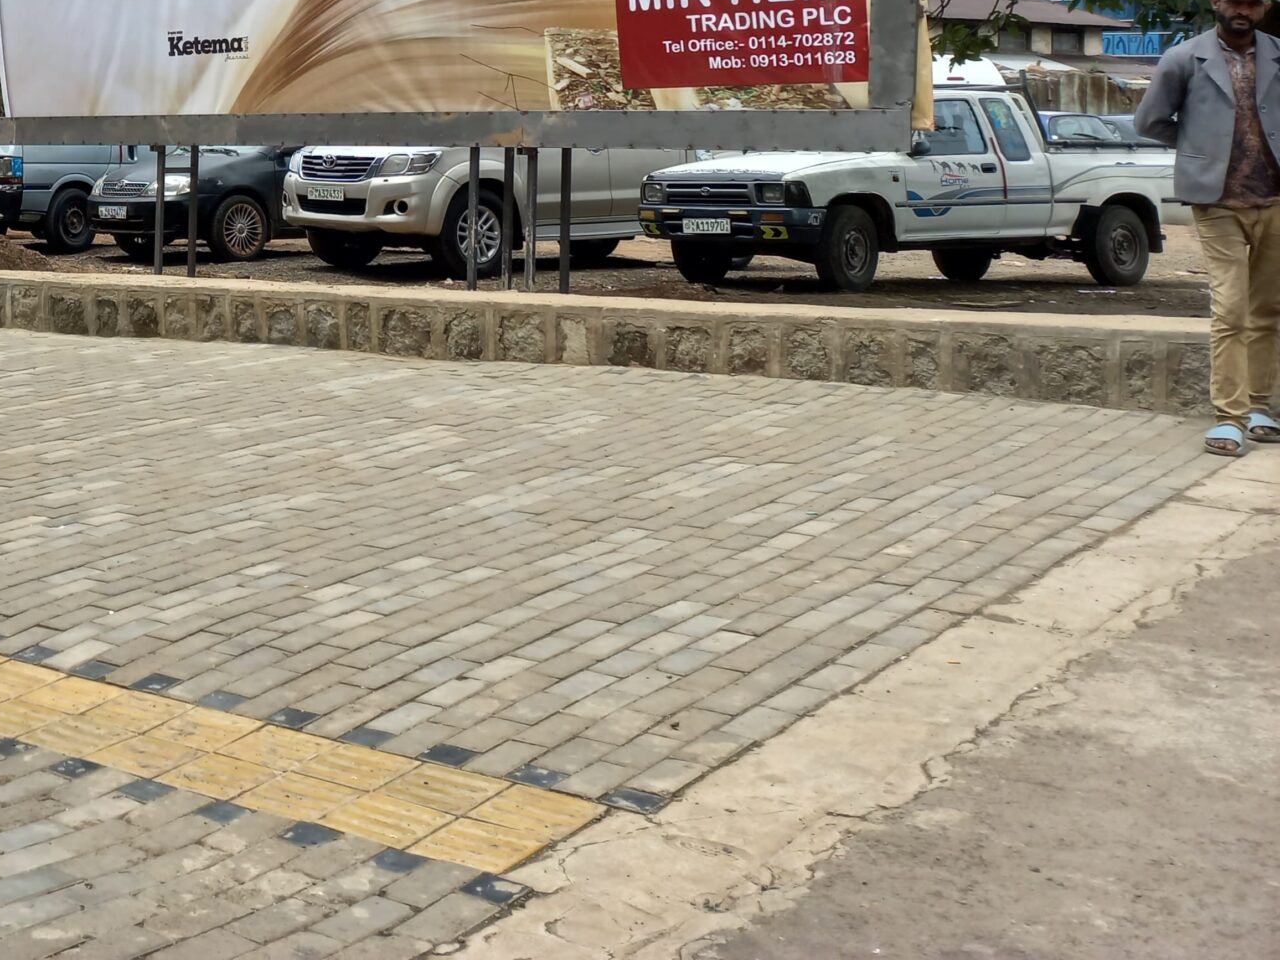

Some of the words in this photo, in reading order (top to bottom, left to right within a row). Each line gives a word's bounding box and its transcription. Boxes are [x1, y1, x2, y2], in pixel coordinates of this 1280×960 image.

[686, 9, 794, 33] TRADING
[802, 5, 852, 27] PLC
[167, 36, 243, 57] Ketema
[662, 40, 684, 54] Tel
[749, 31, 855, 50] 0114-702872
[708, 55, 746, 69] Mob:
[750, 51, 856, 68] 0913-011628
[695, 219, 725, 232] A11970
